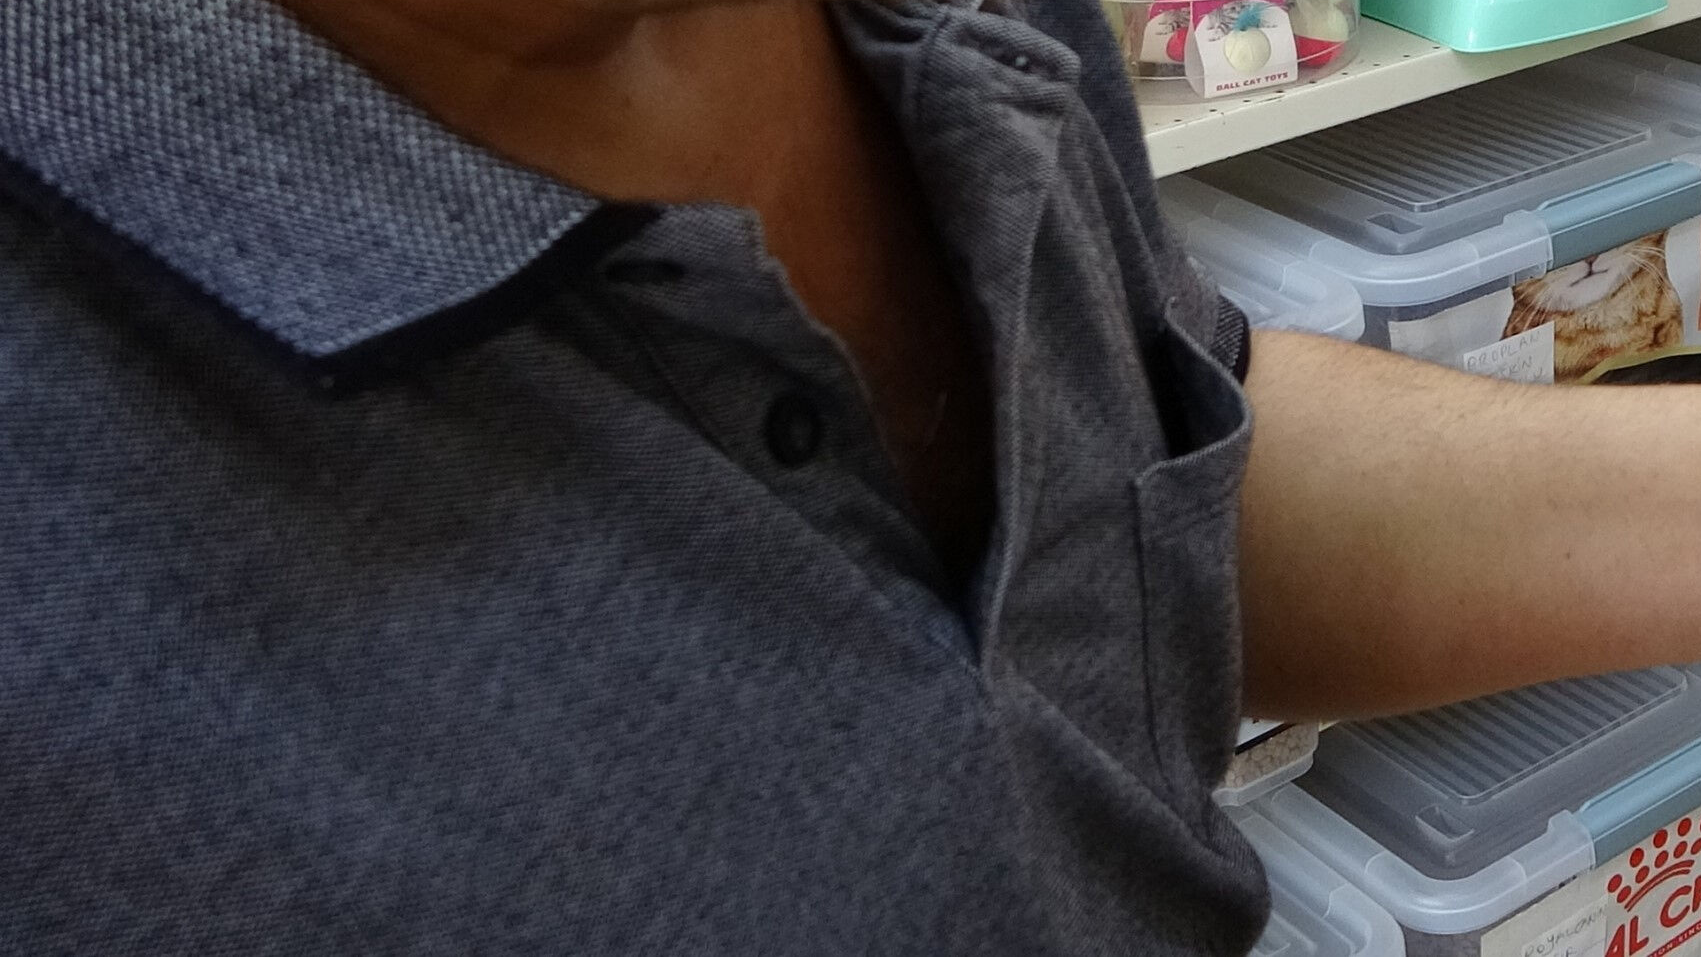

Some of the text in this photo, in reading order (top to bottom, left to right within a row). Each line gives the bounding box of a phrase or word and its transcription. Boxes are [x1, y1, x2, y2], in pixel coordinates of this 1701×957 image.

[1216, 72, 1289, 92] BALL CAT TOYS
